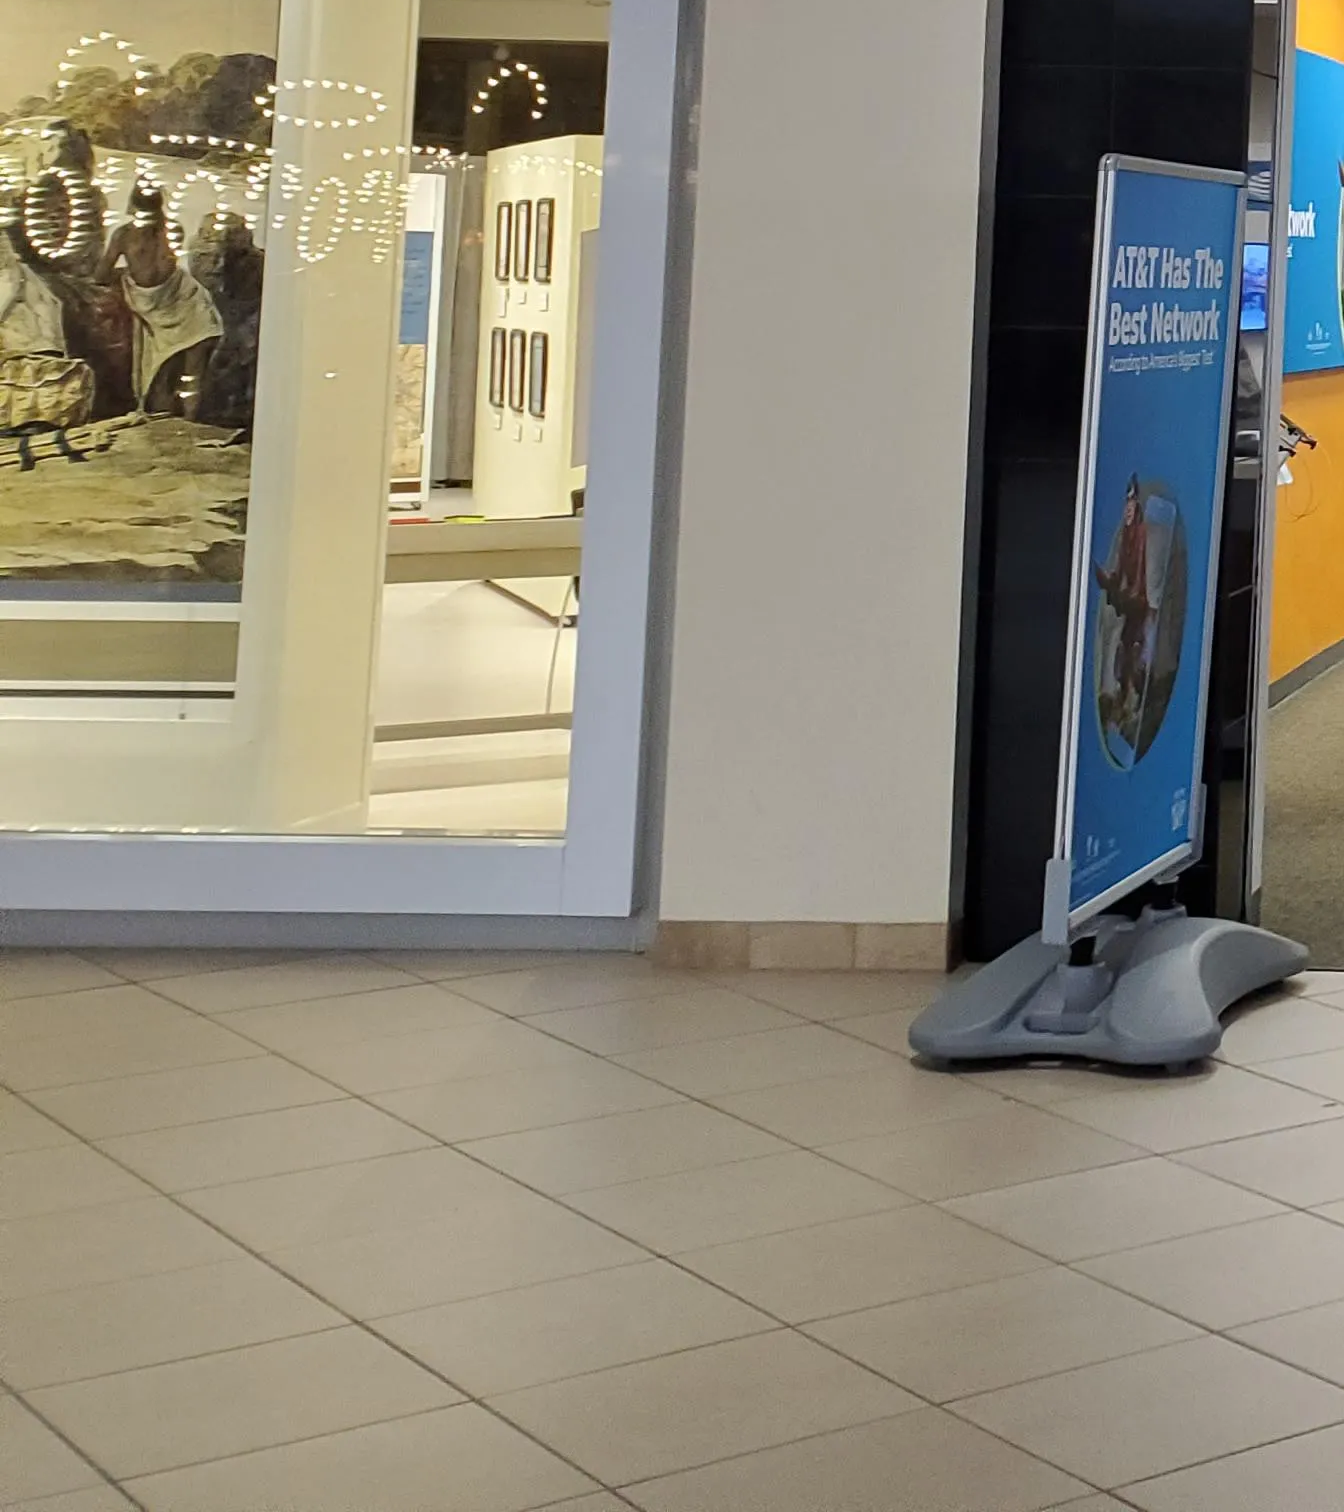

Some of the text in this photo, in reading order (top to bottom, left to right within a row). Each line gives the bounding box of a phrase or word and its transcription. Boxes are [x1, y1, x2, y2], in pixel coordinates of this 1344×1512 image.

[1112, 245, 1224, 290] AT&T Has The
[1108, 299, 1221, 346] Best Network
